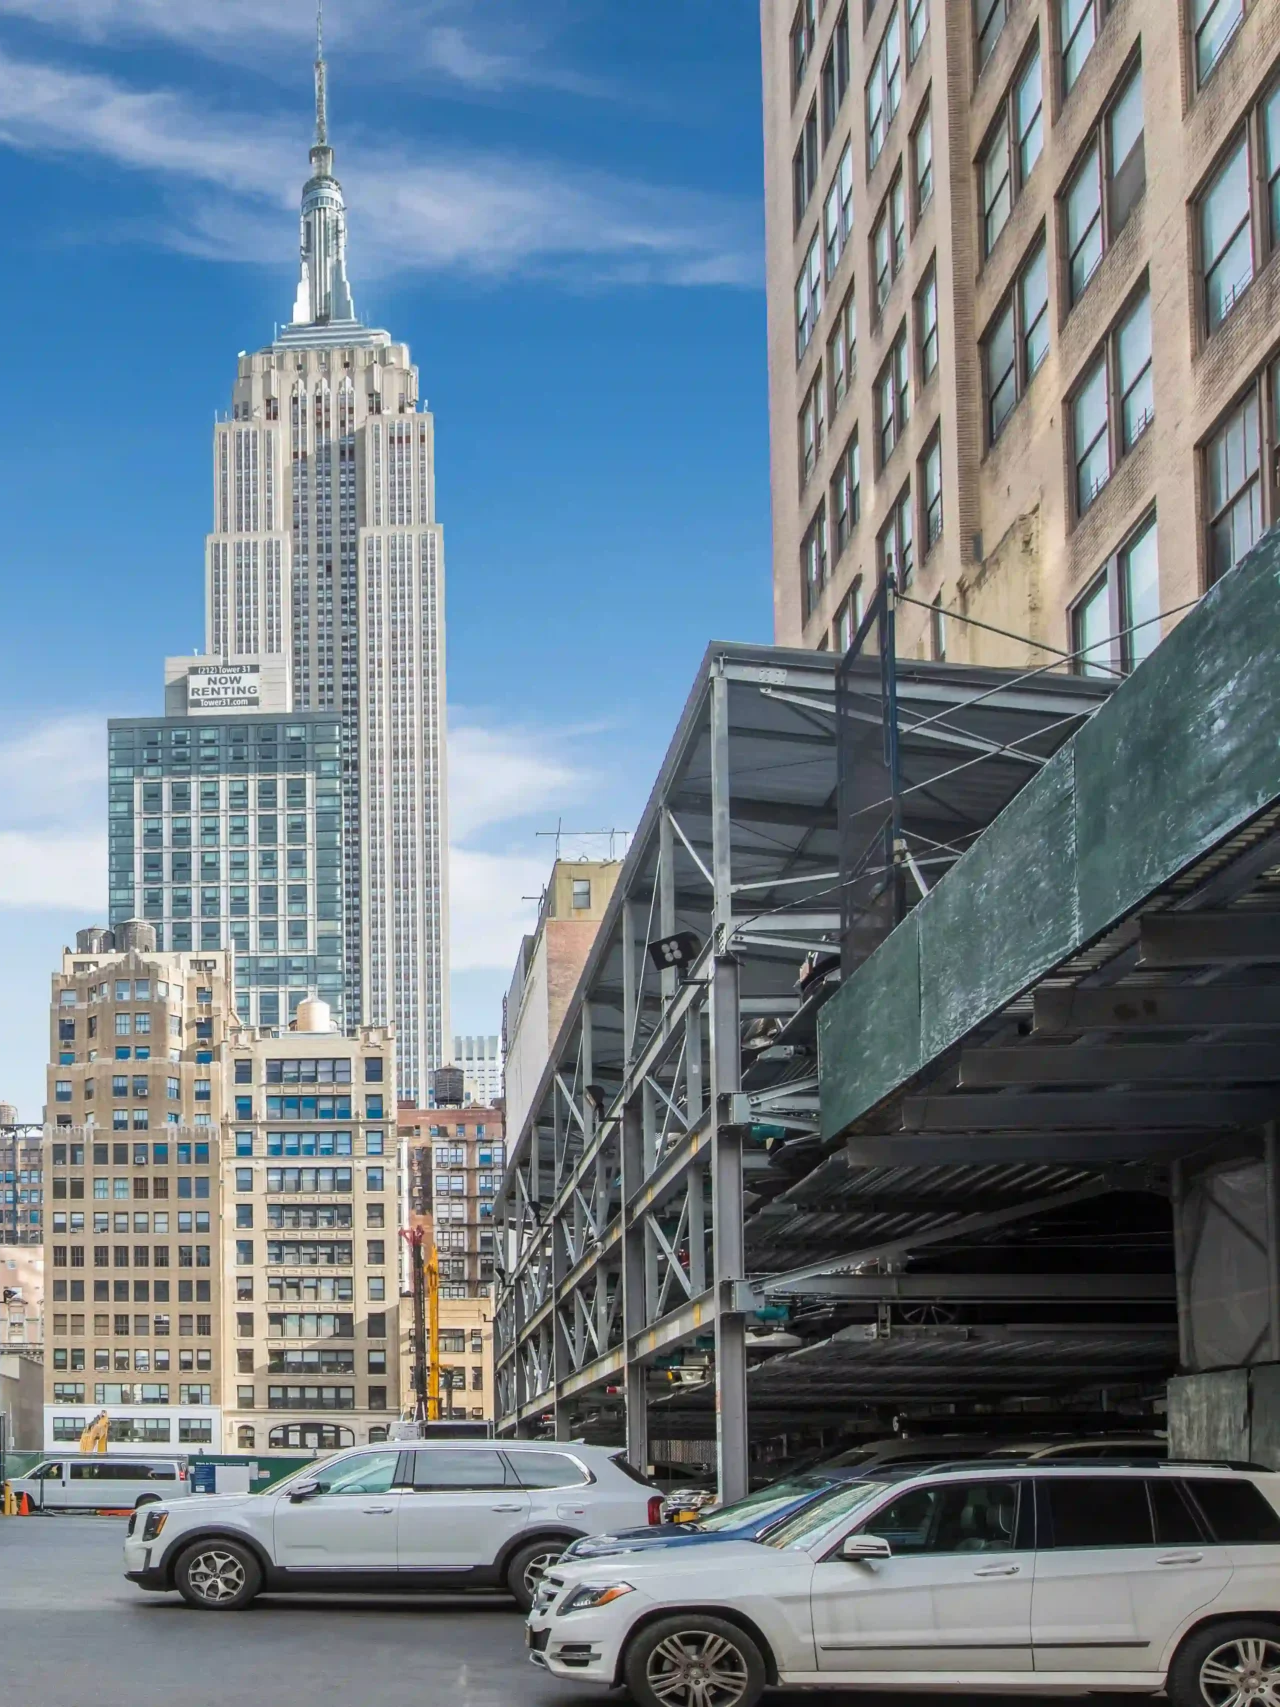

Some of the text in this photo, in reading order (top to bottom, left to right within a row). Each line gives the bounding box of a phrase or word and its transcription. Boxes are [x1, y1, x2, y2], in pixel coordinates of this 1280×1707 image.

[198, 665, 251, 674] (212) Tower 31
[207, 675, 242, 686] NOW
[191, 685, 258, 697] RENTING
[200, 698, 248, 707] Tower31.com
